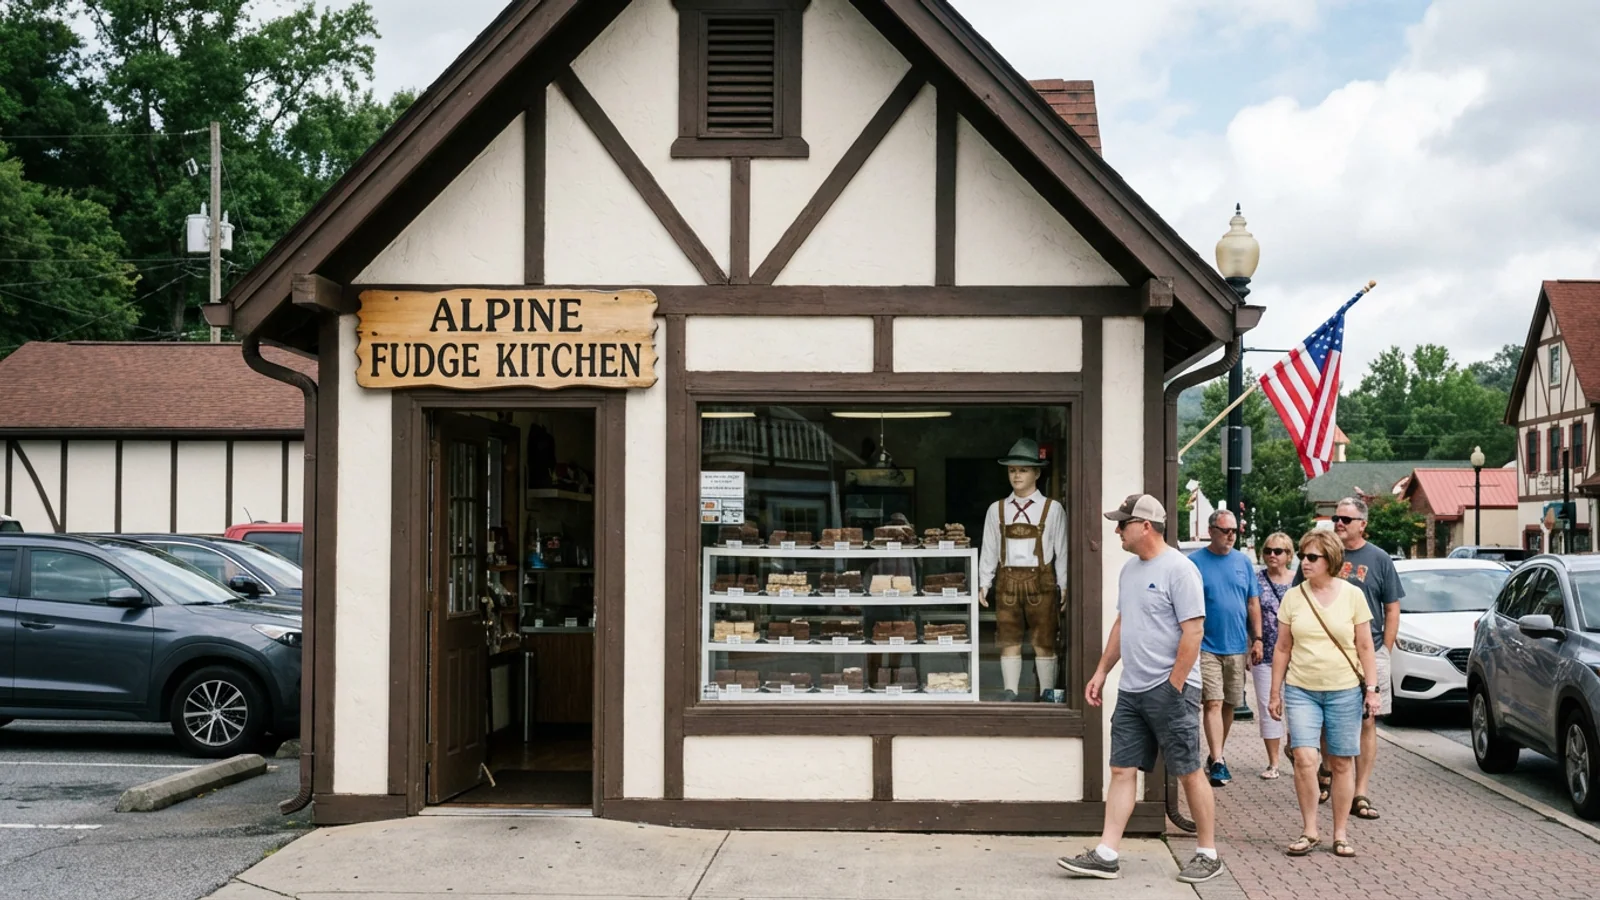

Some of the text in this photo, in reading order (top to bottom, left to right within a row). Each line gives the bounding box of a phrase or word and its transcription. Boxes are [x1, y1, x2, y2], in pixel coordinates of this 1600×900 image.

[429, 297, 583, 332] ALPINE
[370, 342, 642, 378] FUDGE KITCHEN
